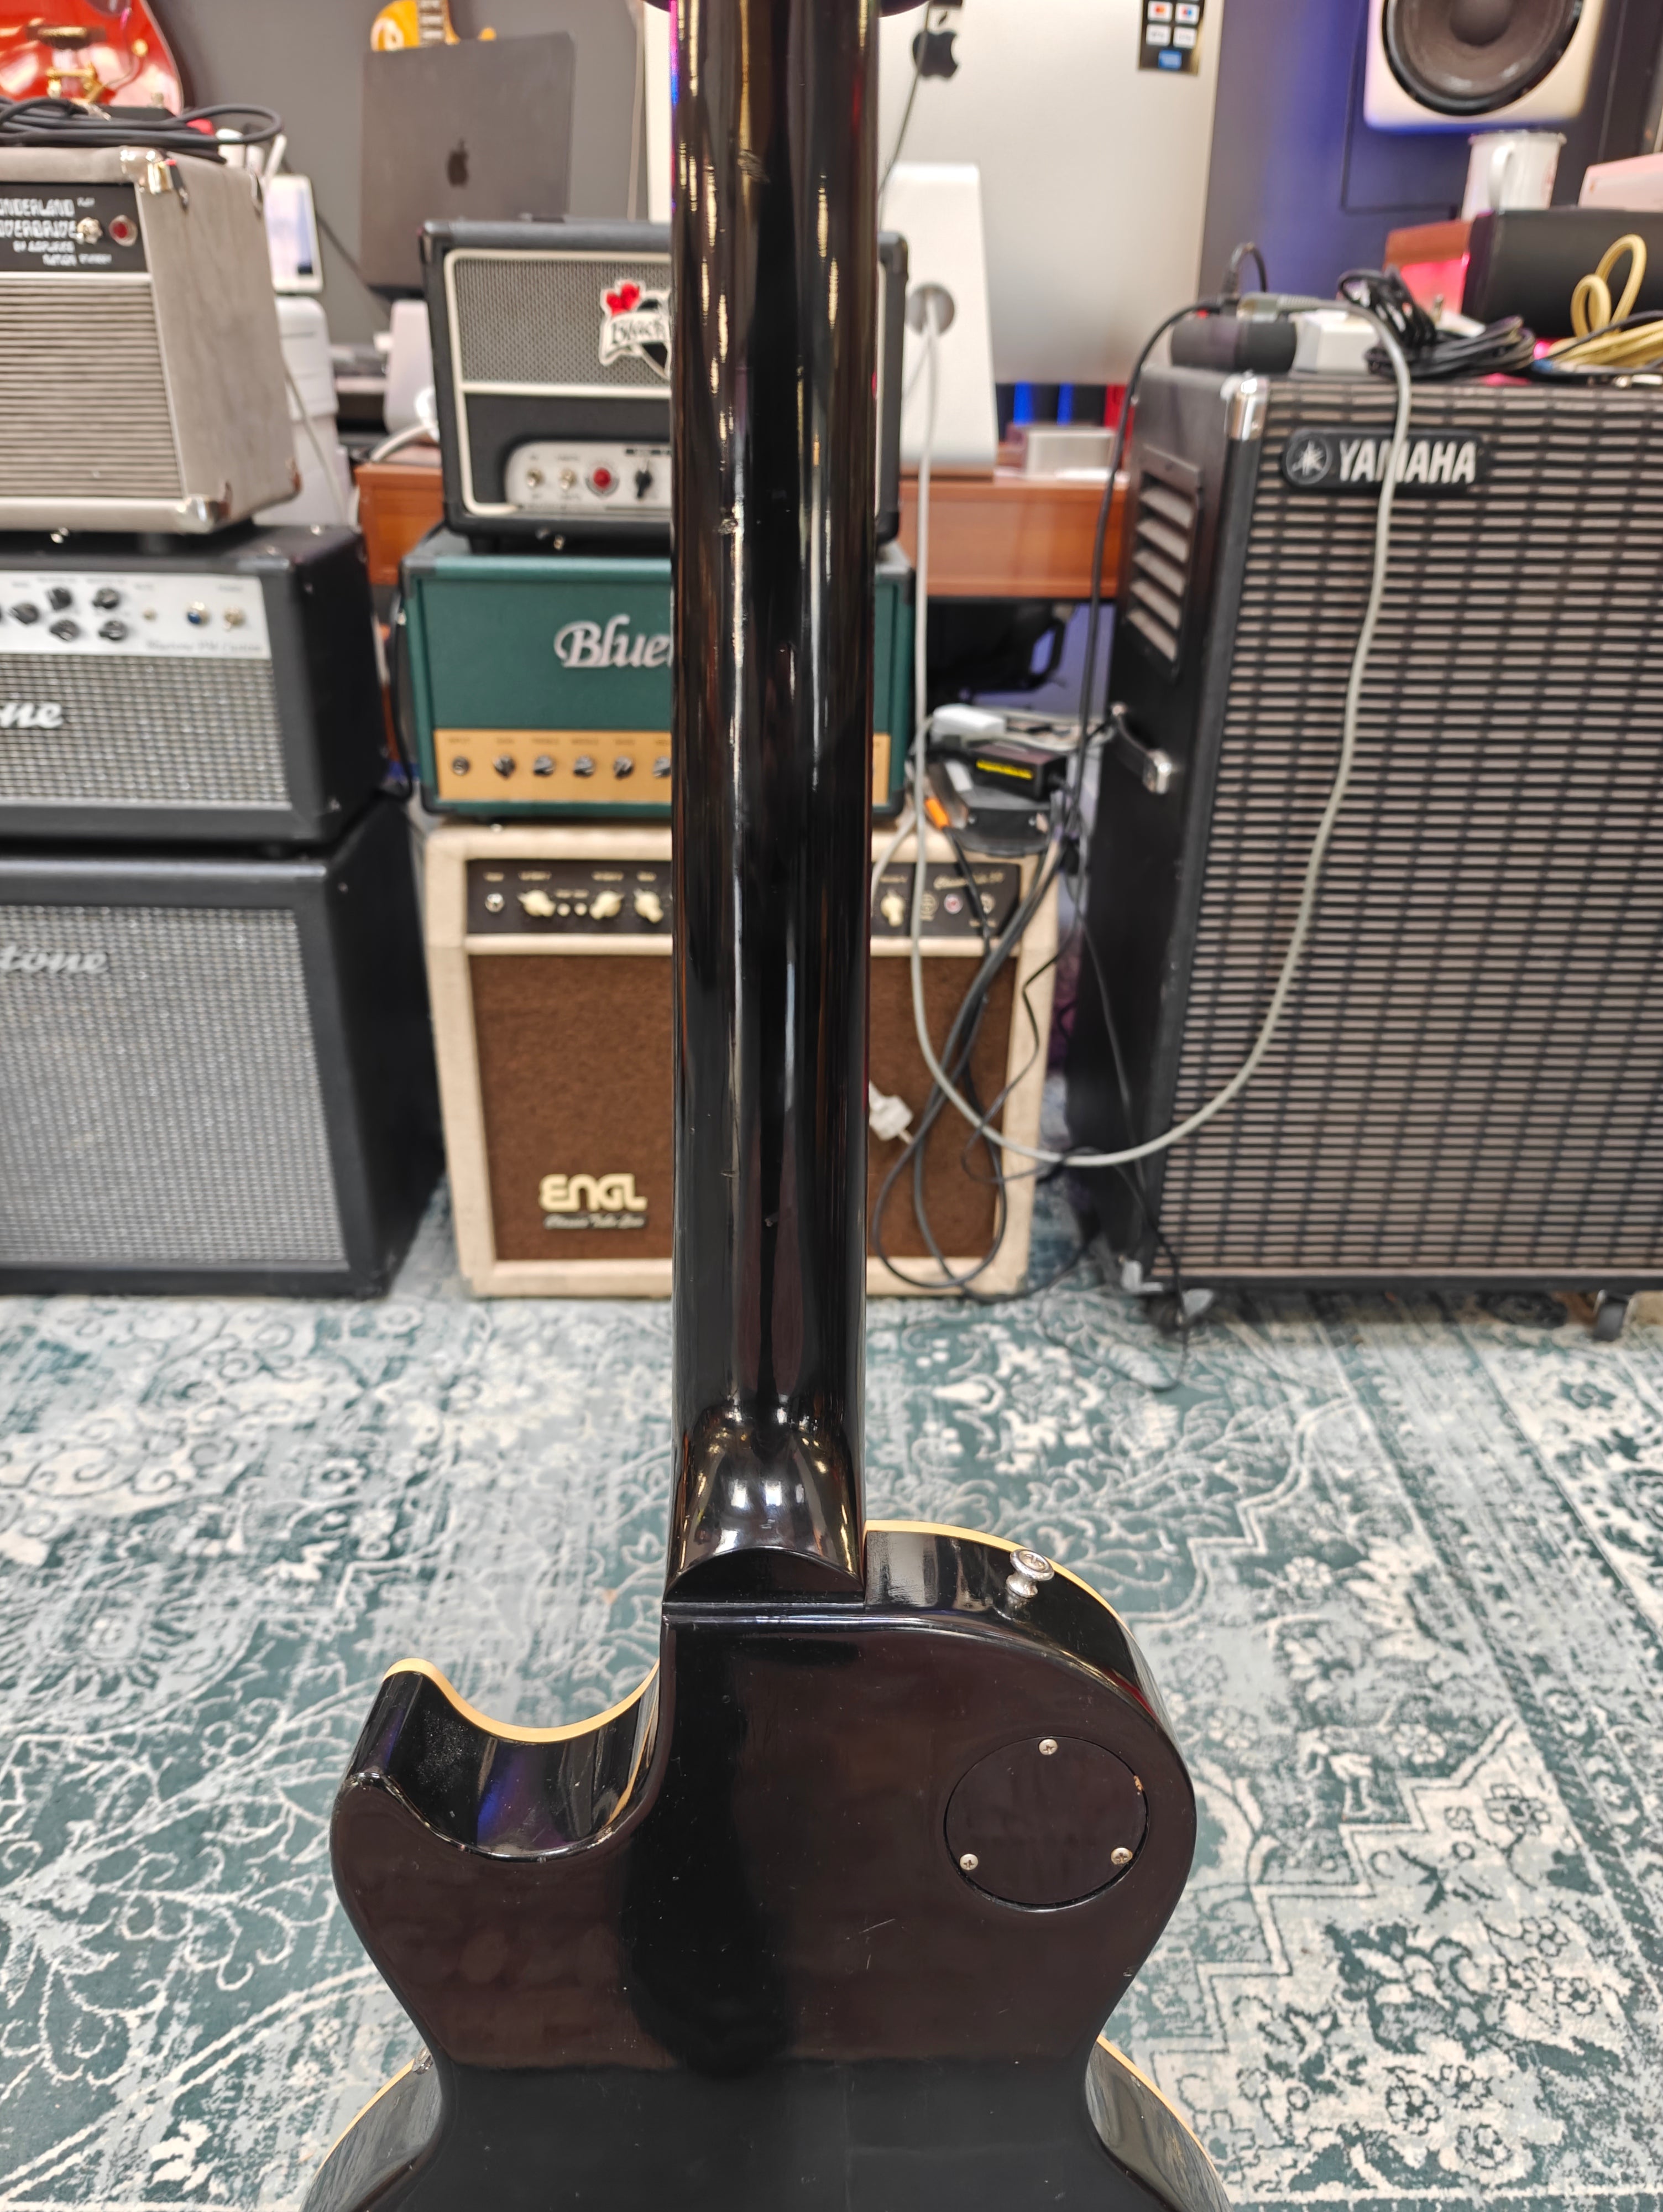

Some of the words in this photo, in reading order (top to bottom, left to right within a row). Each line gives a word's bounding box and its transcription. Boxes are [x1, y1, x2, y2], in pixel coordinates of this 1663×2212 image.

[1339, 440, 1476, 483] YAMAHA
[554, 614, 672, 667] Blue
[539, 1173, 647, 1212] ENGL
